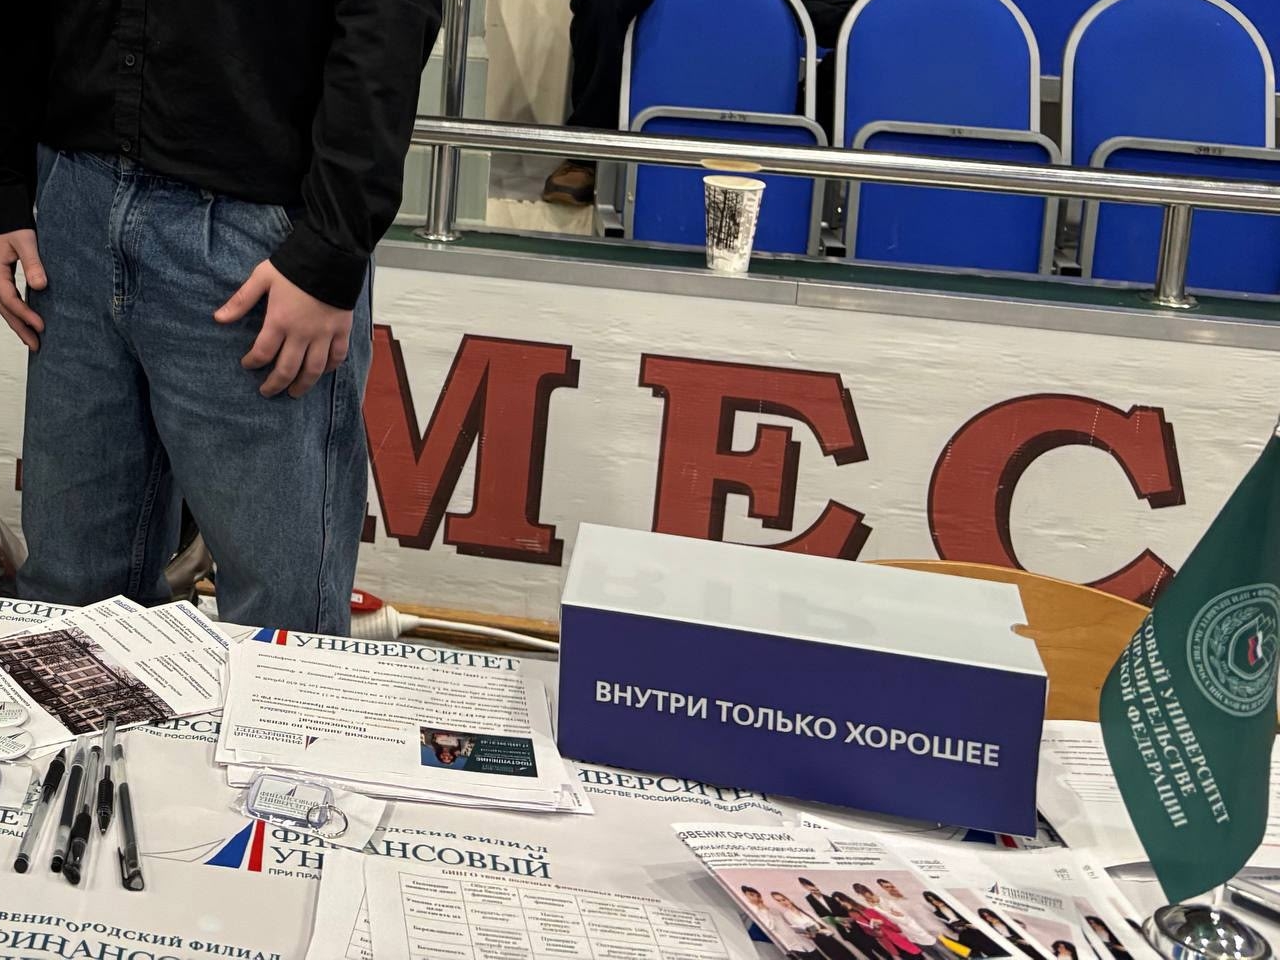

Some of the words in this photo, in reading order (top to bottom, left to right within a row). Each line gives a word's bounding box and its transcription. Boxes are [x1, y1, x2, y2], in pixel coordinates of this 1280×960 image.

[293, 634, 521, 671] УНИВЕРСИТЕТ
[595, 680, 708, 719] ВНУТРИ
[715, 699, 838, 740] ТОЛЬКО
[844, 721, 1000, 767] ХОРОШЕЕ
[1127, 704, 1188, 828] ФЕДЕРАЦИИ
[1160, 684, 1230, 825] УНИВЕРСИТЕТ
[634, 793, 712, 808] РОССИЙСКОЙ
[714, 801, 784, 817] ФЕДЕРАЦИИ
[462, 835, 548, 854] ФИЛИАЛ
[679, 830, 795, 843] ЗВЕНИГОРОДСКИЙ
[268, 867, 293, 877] ПРИ
